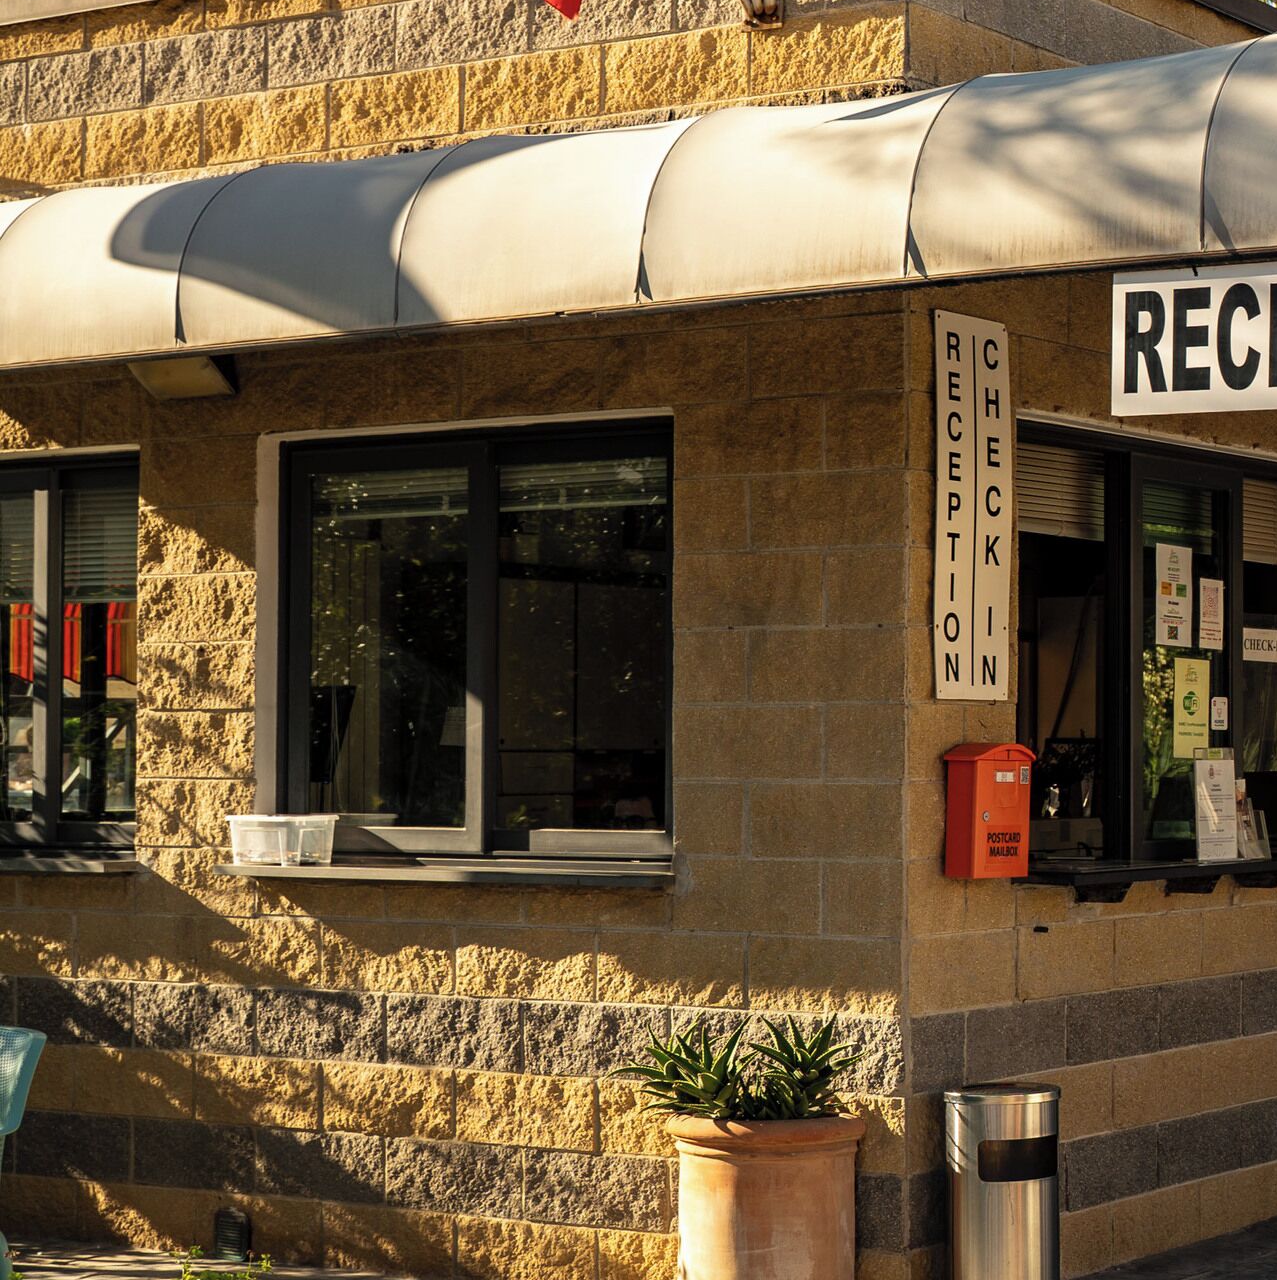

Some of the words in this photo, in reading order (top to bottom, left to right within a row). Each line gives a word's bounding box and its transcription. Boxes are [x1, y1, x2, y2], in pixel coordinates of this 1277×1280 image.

[982, 338, 1001, 567] CHECK
[944, 331, 964, 685] RECEPTION
[981, 605, 997, 686] IN
[987, 832, 1021, 845] POSTCARD
[988, 846, 1019, 857] MAILBOX
